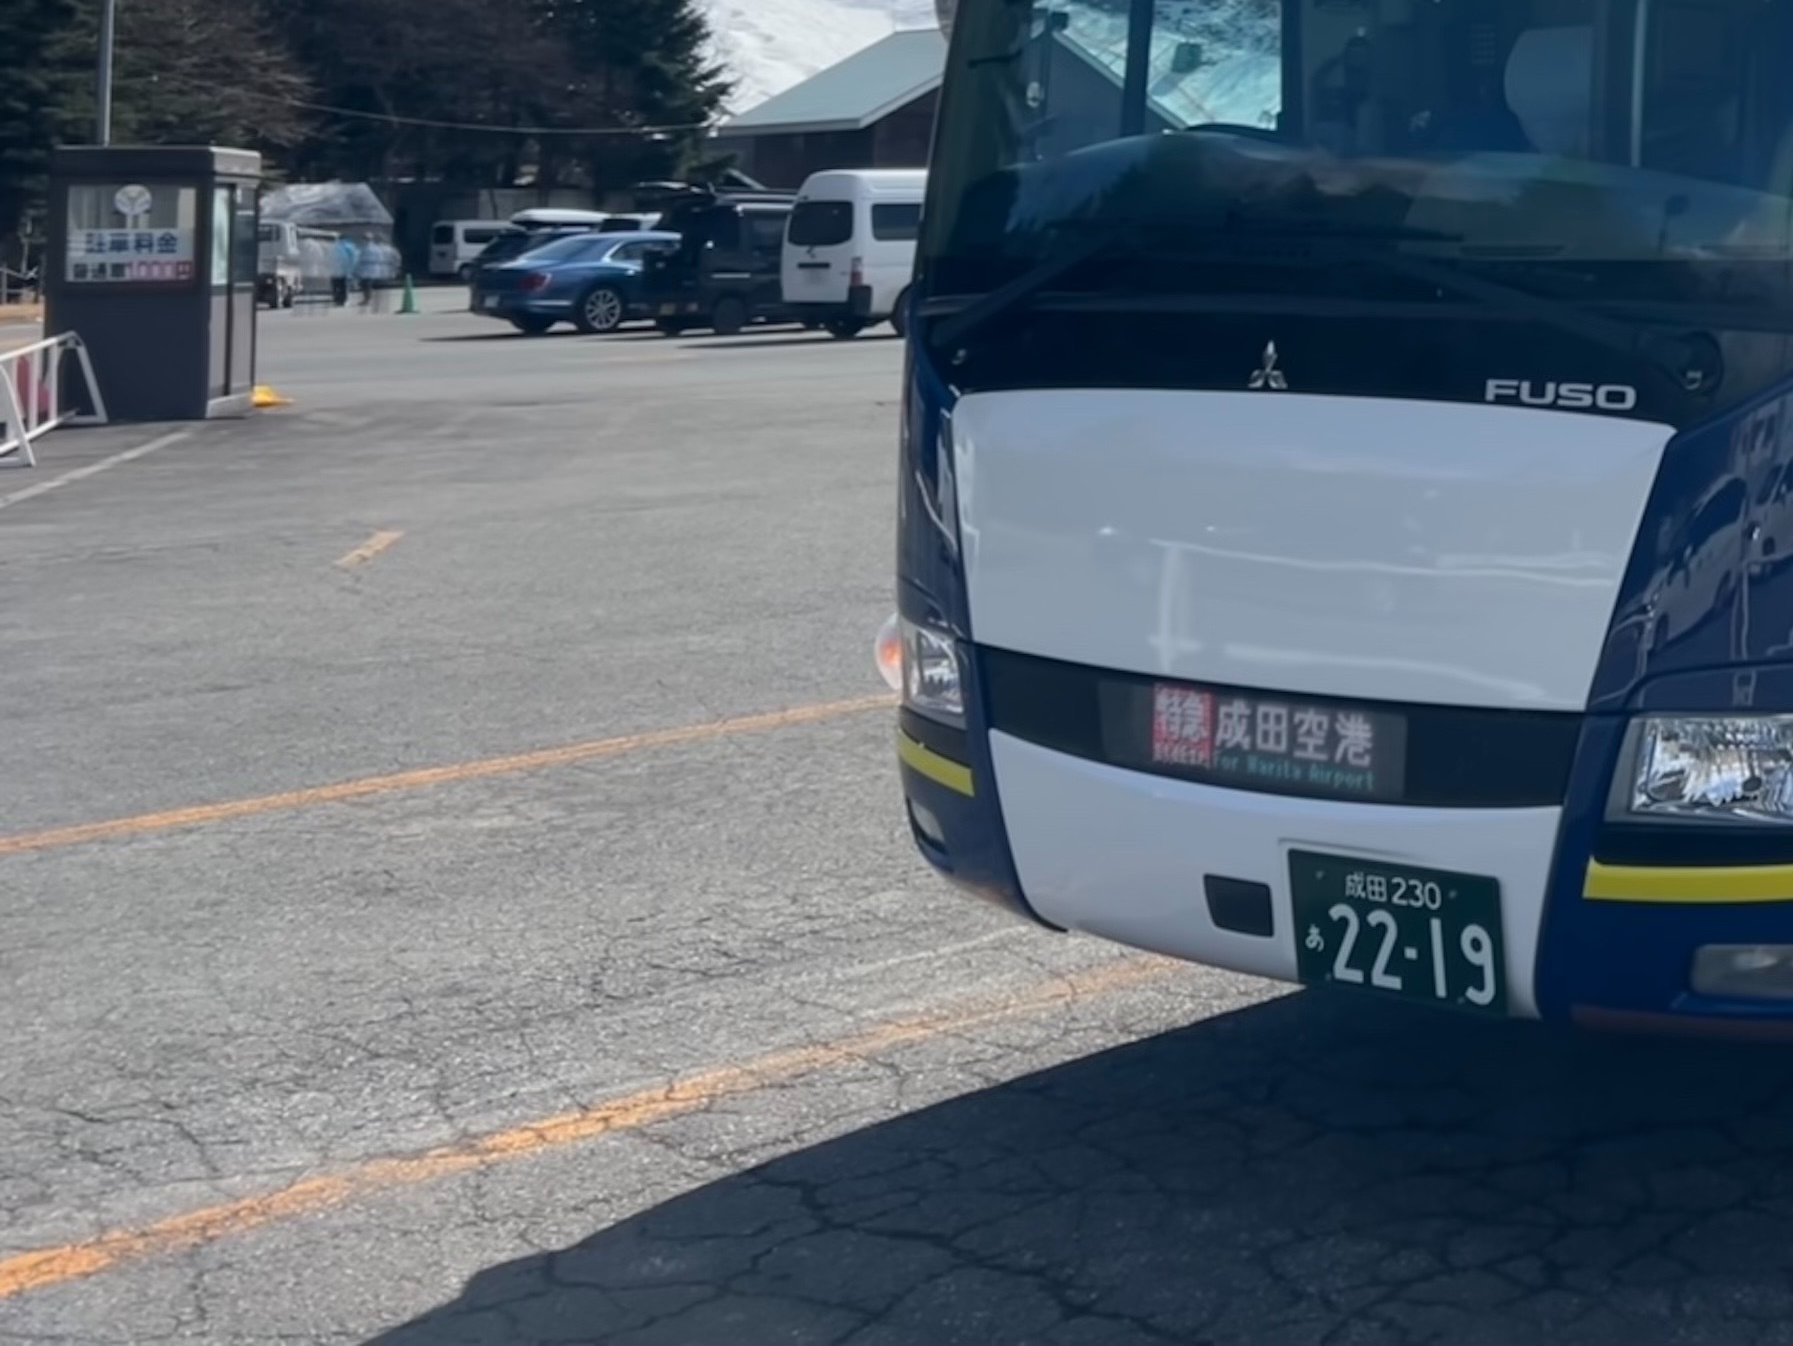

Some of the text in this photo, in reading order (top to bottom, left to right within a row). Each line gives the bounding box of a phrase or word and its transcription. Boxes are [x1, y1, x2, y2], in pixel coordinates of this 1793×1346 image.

[1485, 378, 1637, 410] FUSO
[1214, 699, 1373, 767] 成田空港
[1308, 762, 1375, 792] Airport
[1345, 871, 1442, 911] 成田 230
[1305, 903, 1496, 1006] あ 22-19
